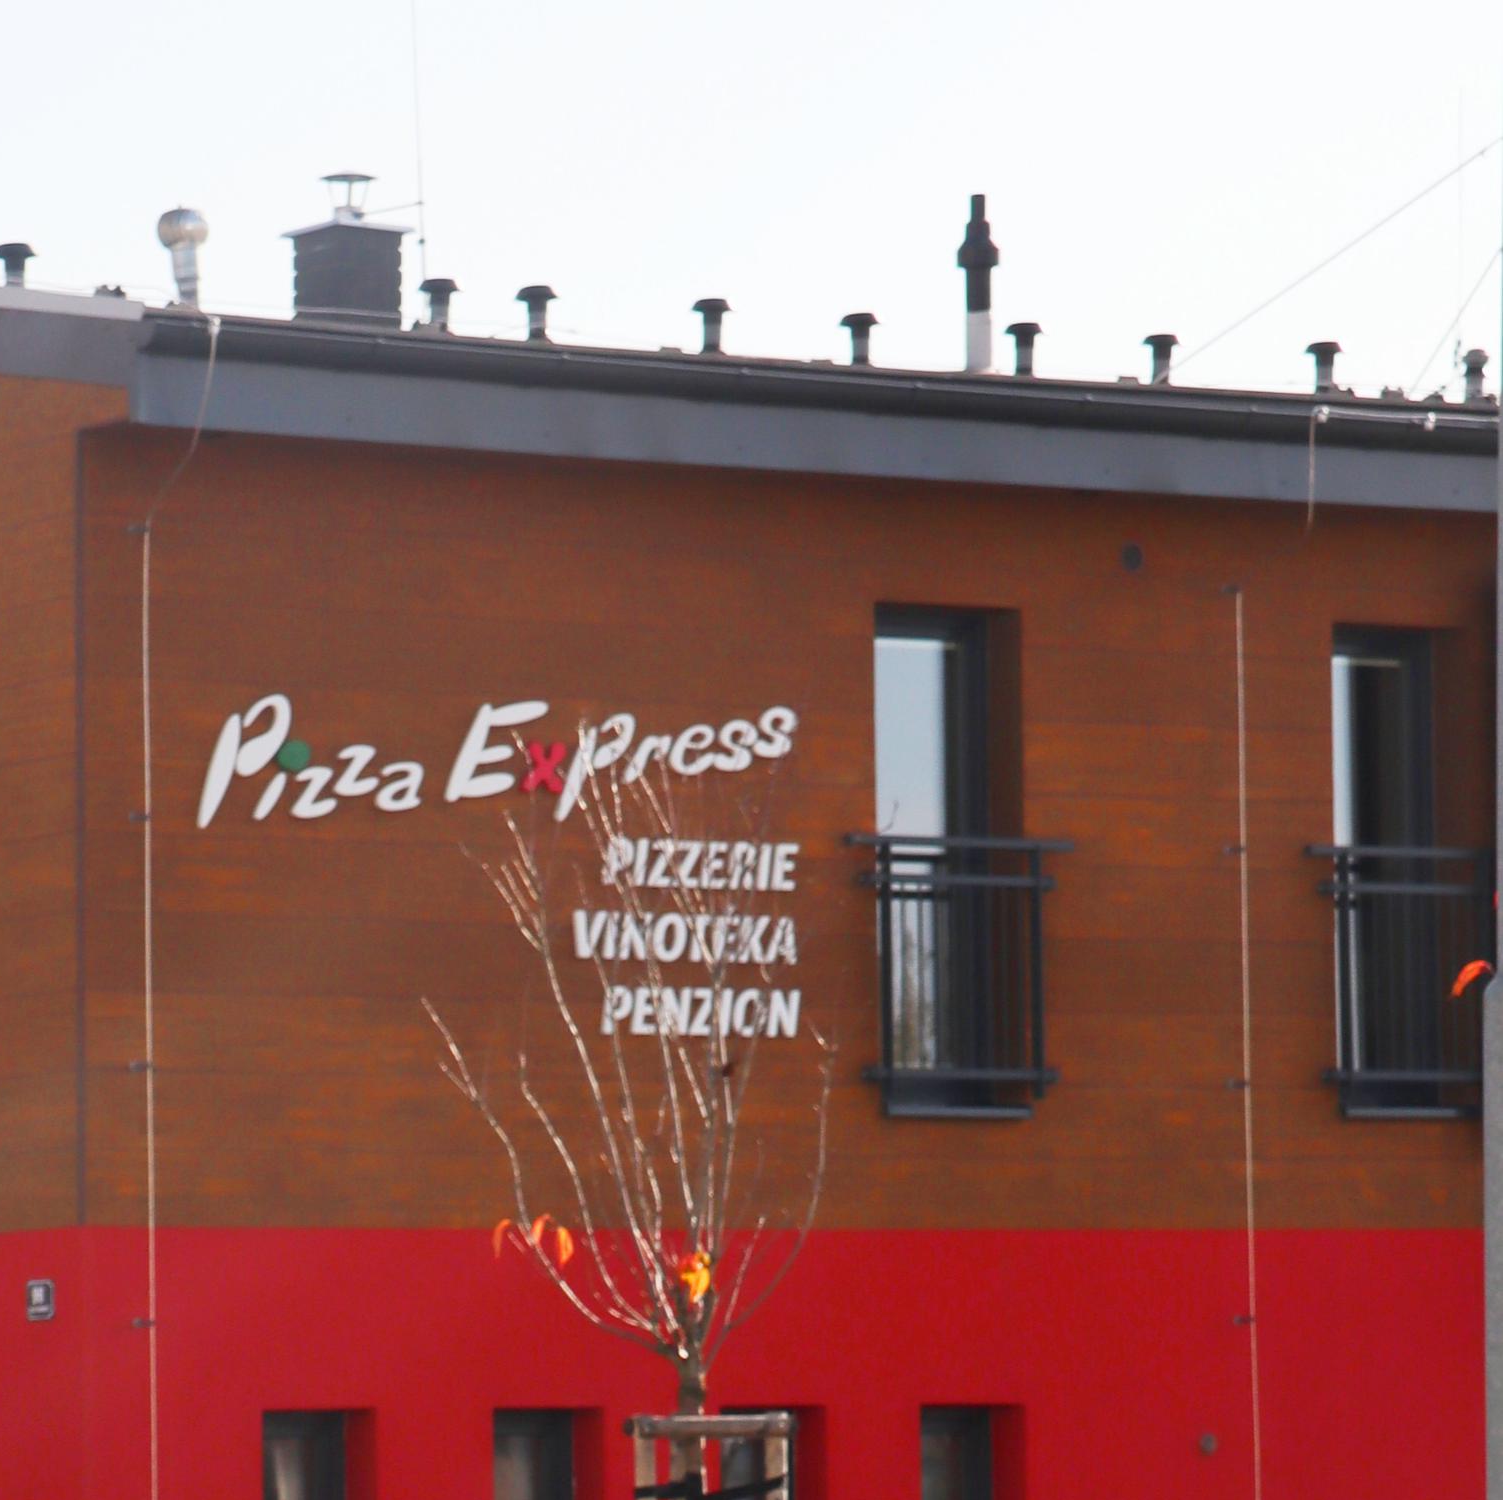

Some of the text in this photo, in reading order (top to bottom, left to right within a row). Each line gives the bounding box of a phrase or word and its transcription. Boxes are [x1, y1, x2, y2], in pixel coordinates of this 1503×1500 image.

[197, 693, 424, 829] Pizza
[601, 837, 800, 892] PIZZERIE
[601, 984, 801, 1039] PENZION
